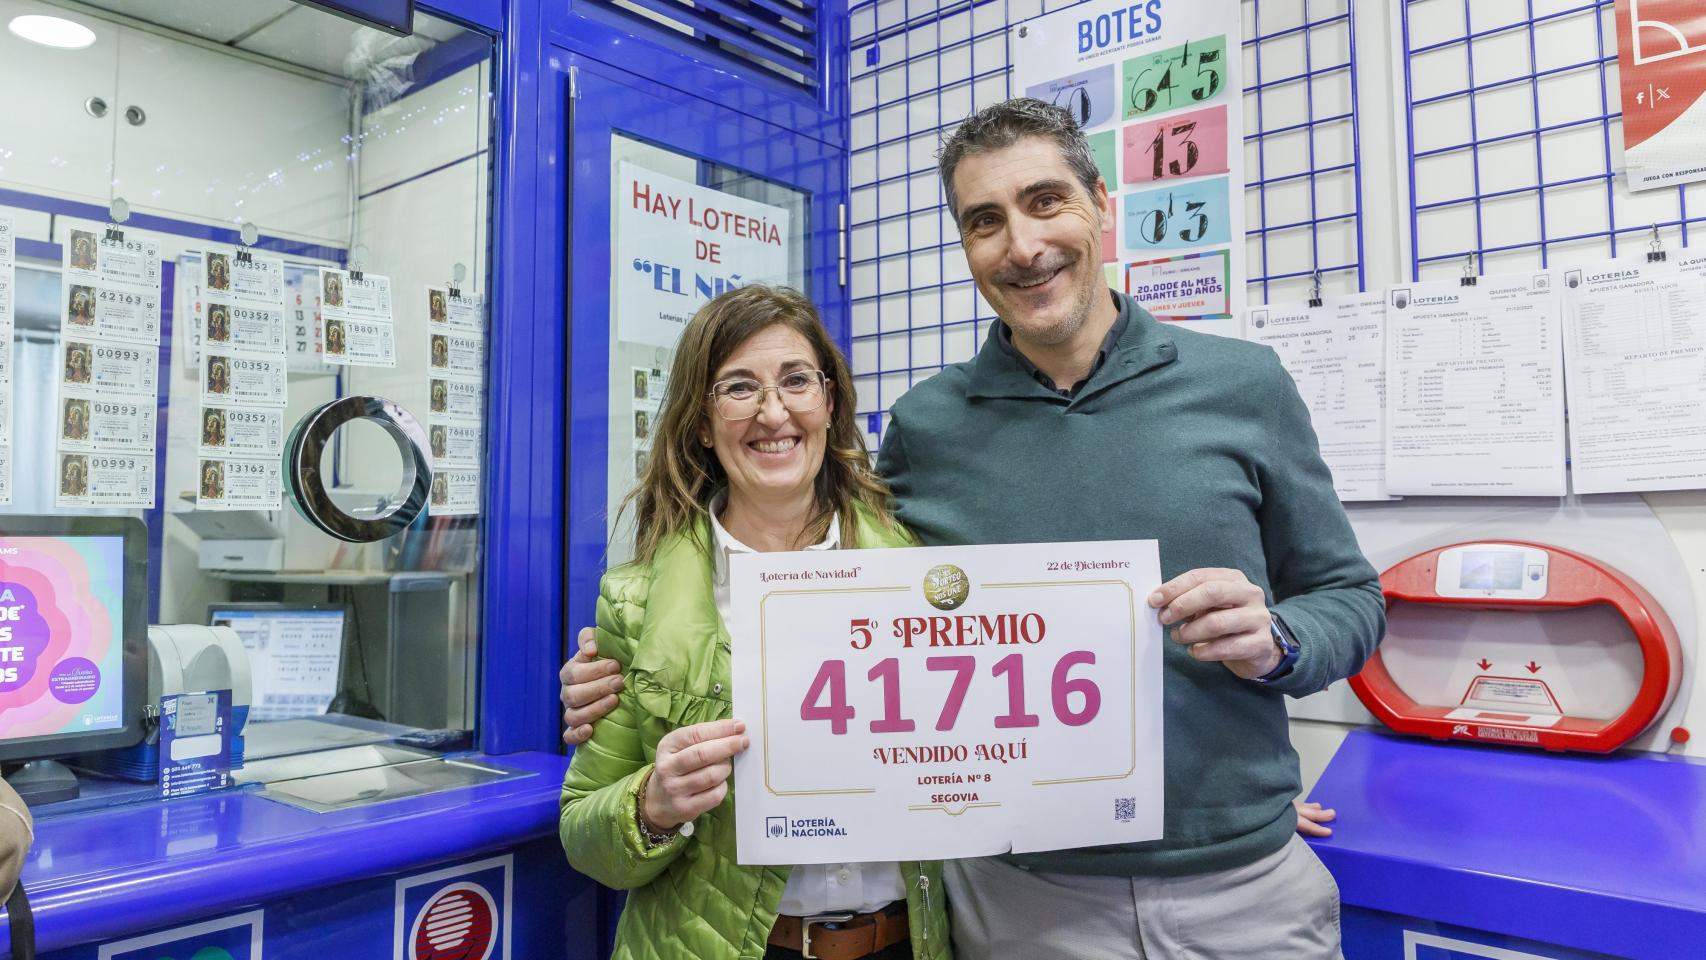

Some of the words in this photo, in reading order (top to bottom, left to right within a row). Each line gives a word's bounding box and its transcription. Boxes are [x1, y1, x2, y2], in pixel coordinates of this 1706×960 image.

[1078, 0, 1162, 54] BOTES
[1145, 121, 1199, 181] 13
[633, 180, 682, 220] HAY
[688, 197, 782, 246] LOTERÍA
[695, 239, 721, 264] DE
[1586, 269, 1640, 282] LOTERÍAS
[1181, 280, 1194, 289] AL
[1196, 276, 1217, 286] MES
[99, 291, 142, 305] 42163
[1134, 290, 1178, 302] DURANTE
[1180, 288, 1193, 297] 30
[1195, 284, 1222, 295] AÑOS
[1413, 295, 1459, 304] LOTERÍAS
[1177, 299, 1205, 309] JUEVES
[234, 309, 269, 321] 00352
[1270, 315, 1310, 323] LOTERÍAS
[97, 348, 139, 361] 00993
[234, 360, 270, 371] 00352
[94, 403, 137, 416] 00993
[229, 412, 266, 423] 00352
[92, 459, 135, 469] 00993
[228, 464, 265, 474] 13162
[1046, 561, 1059, 571] 22
[1060, 561, 1073, 570] de
[1074, 560, 1131, 571] Diciembre
[801, 570, 814, 580] de
[892, 612, 1046, 648] PREMIO
[800, 650, 1102, 735] 41716
[873, 744, 968, 765] VENDIDO
[974, 738, 1028, 764] AQUÍ
[917, 772, 963, 785] LOTERÍA
[983, 773, 992, 783] 8
[931, 792, 979, 804] SEGOVIA
[791, 816, 836, 828] LOTERÍA
[791, 827, 848, 838] NACIONAL
